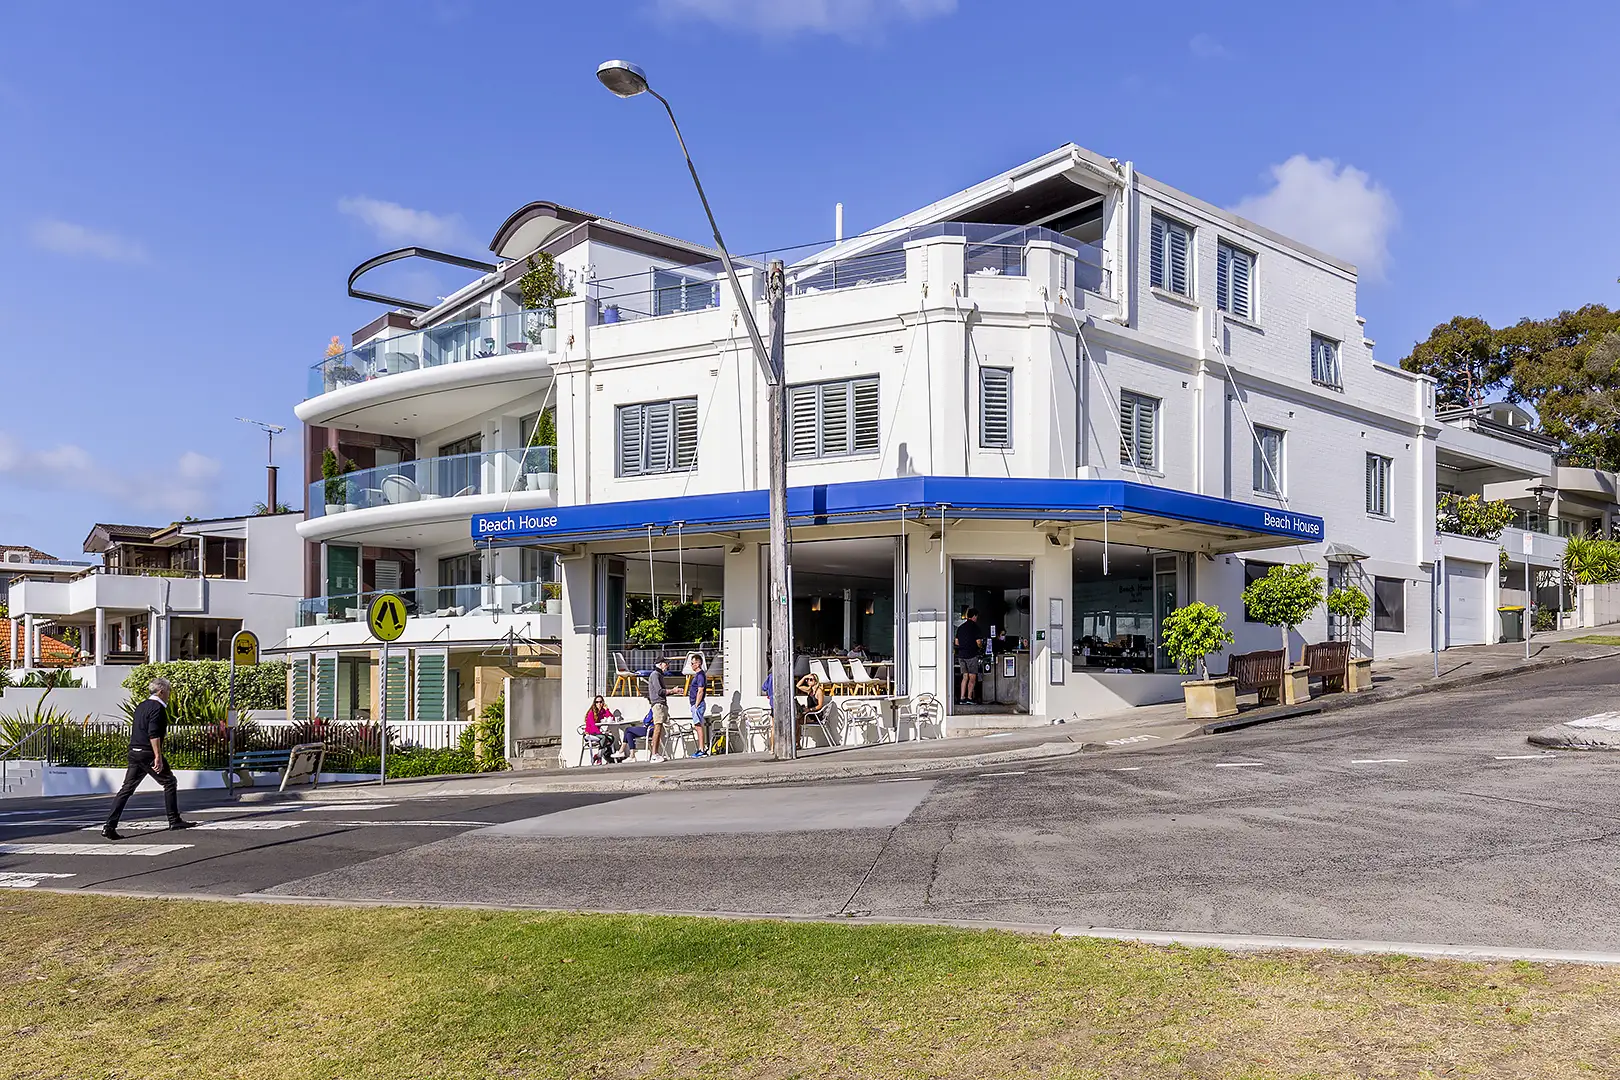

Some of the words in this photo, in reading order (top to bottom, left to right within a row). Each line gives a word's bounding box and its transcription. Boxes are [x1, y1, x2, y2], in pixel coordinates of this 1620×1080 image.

[479, 516, 515, 532] Beach
[519, 515, 557, 529] House
[1264, 512, 1290, 529] Beach
[1293, 517, 1320, 535] House
